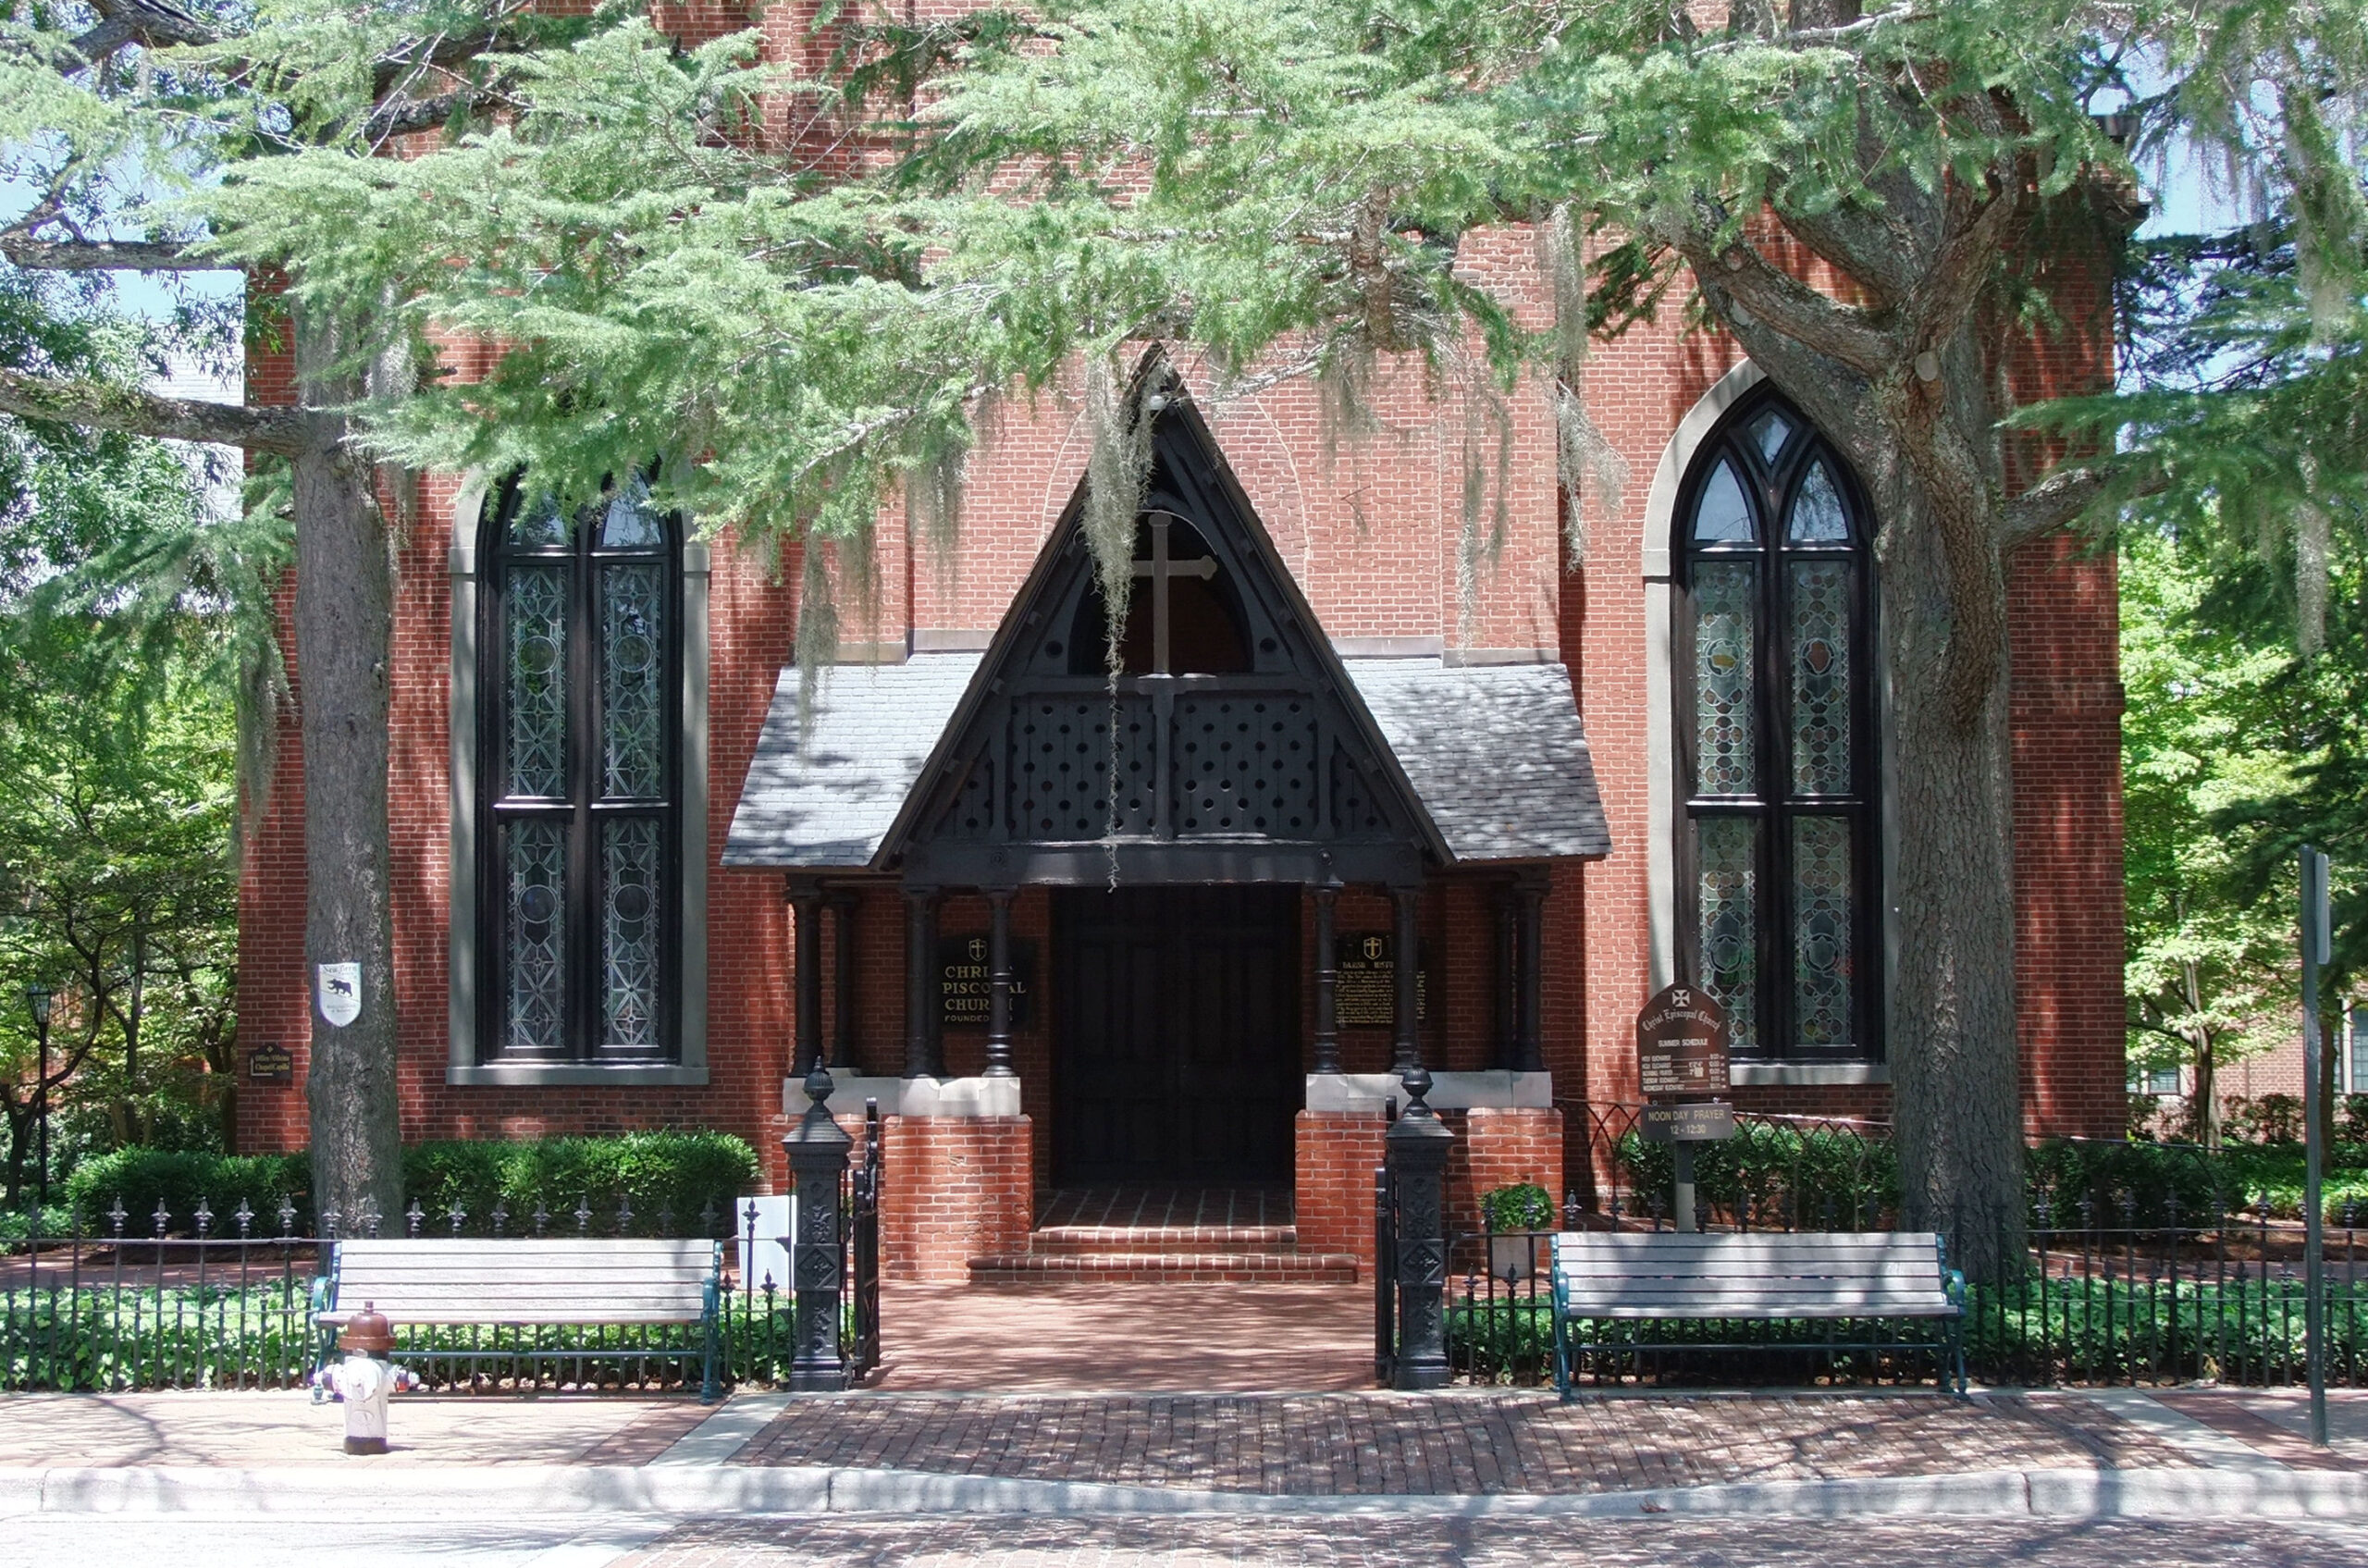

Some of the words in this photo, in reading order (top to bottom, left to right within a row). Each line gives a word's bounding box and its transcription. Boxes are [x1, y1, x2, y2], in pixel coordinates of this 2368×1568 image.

[944, 966, 1013, 978] CHRI
[944, 998, 1013, 1010] CHUR
[1642, 1014, 1664, 1031] Christ
[1663, 1008, 1697, 1022] Episcopal
[1698, 1010, 1721, 1032] Church
[1658, 1039, 1681, 1047] SUMMER
[1682, 1038, 1708, 1046] SCHEDULE
[1694, 1109, 1725, 1119] PRAYER
[1670, 1125, 1679, 1135] 12
[1686, 1124, 1707, 1134] 12:30
